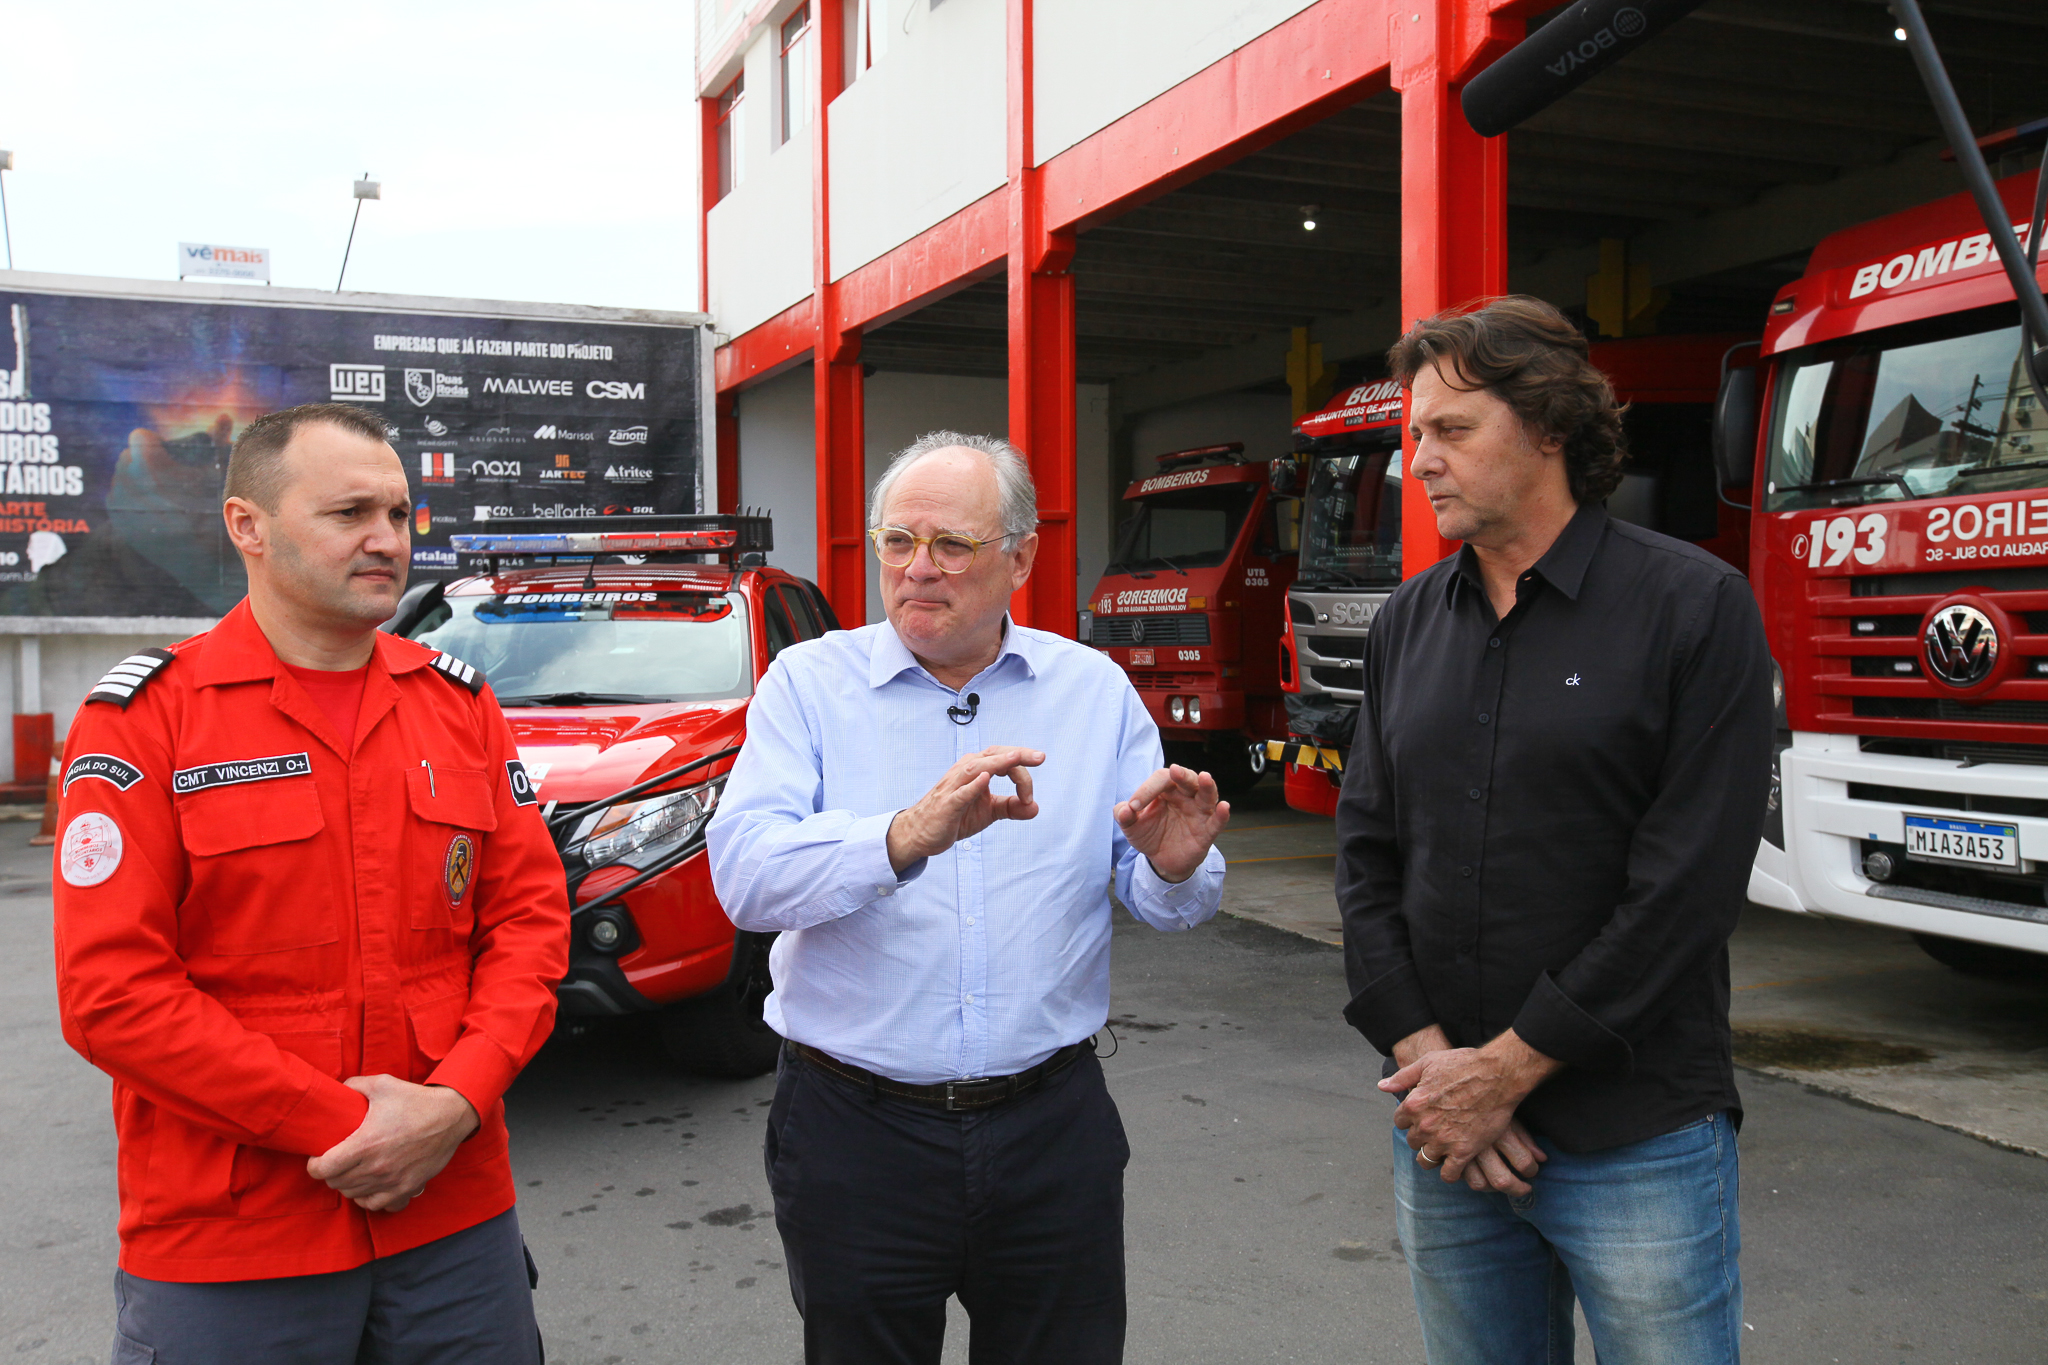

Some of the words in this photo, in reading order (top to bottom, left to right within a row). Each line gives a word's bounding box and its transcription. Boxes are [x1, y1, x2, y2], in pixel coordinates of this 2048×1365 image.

[1545, 28, 1617, 77] BOYA
[374, 335, 436, 353] EMPRESAS
[437, 338, 460, 354] QUE
[461, 337, 475, 354] JÁ
[476, 340, 512, 356] FAZEM
[513, 341, 548, 358] PARTE
[549, 343, 566, 359] DO
[567, 344, 613, 361] PROJETO
[436, 373, 463, 385] Duas
[483, 377, 573, 396] MALWEE
[436, 385, 469, 395] Rodas
[586, 380, 645, 400] CSM
[1314, 406, 1365, 423] VOLUNTÁRIOS
[1366, 403, 1378, 413] DE
[558, 430, 595, 441] Marisol
[618, 465, 653, 478] tritec
[1141, 469, 1210, 493] BOMBEIROS
[633, 506, 656, 514] SOL
[1808, 513, 1888, 568] 193
[1247, 568, 1266, 577] UTB
[1244, 577, 1269, 586] 0305
[504, 592, 658, 605] BOMBEIROS
[1101, 598, 1112, 614] 193
[1178, 650, 1200, 661] 0305
[1565, 673, 1581, 686] ck
[92, 762, 108, 770] DO
[109, 765, 130, 781] SUL
[177, 770, 208, 787] CMT
[215, 761, 280, 780] VINCENZI
[1916, 830, 2004, 860] MIA3A53
